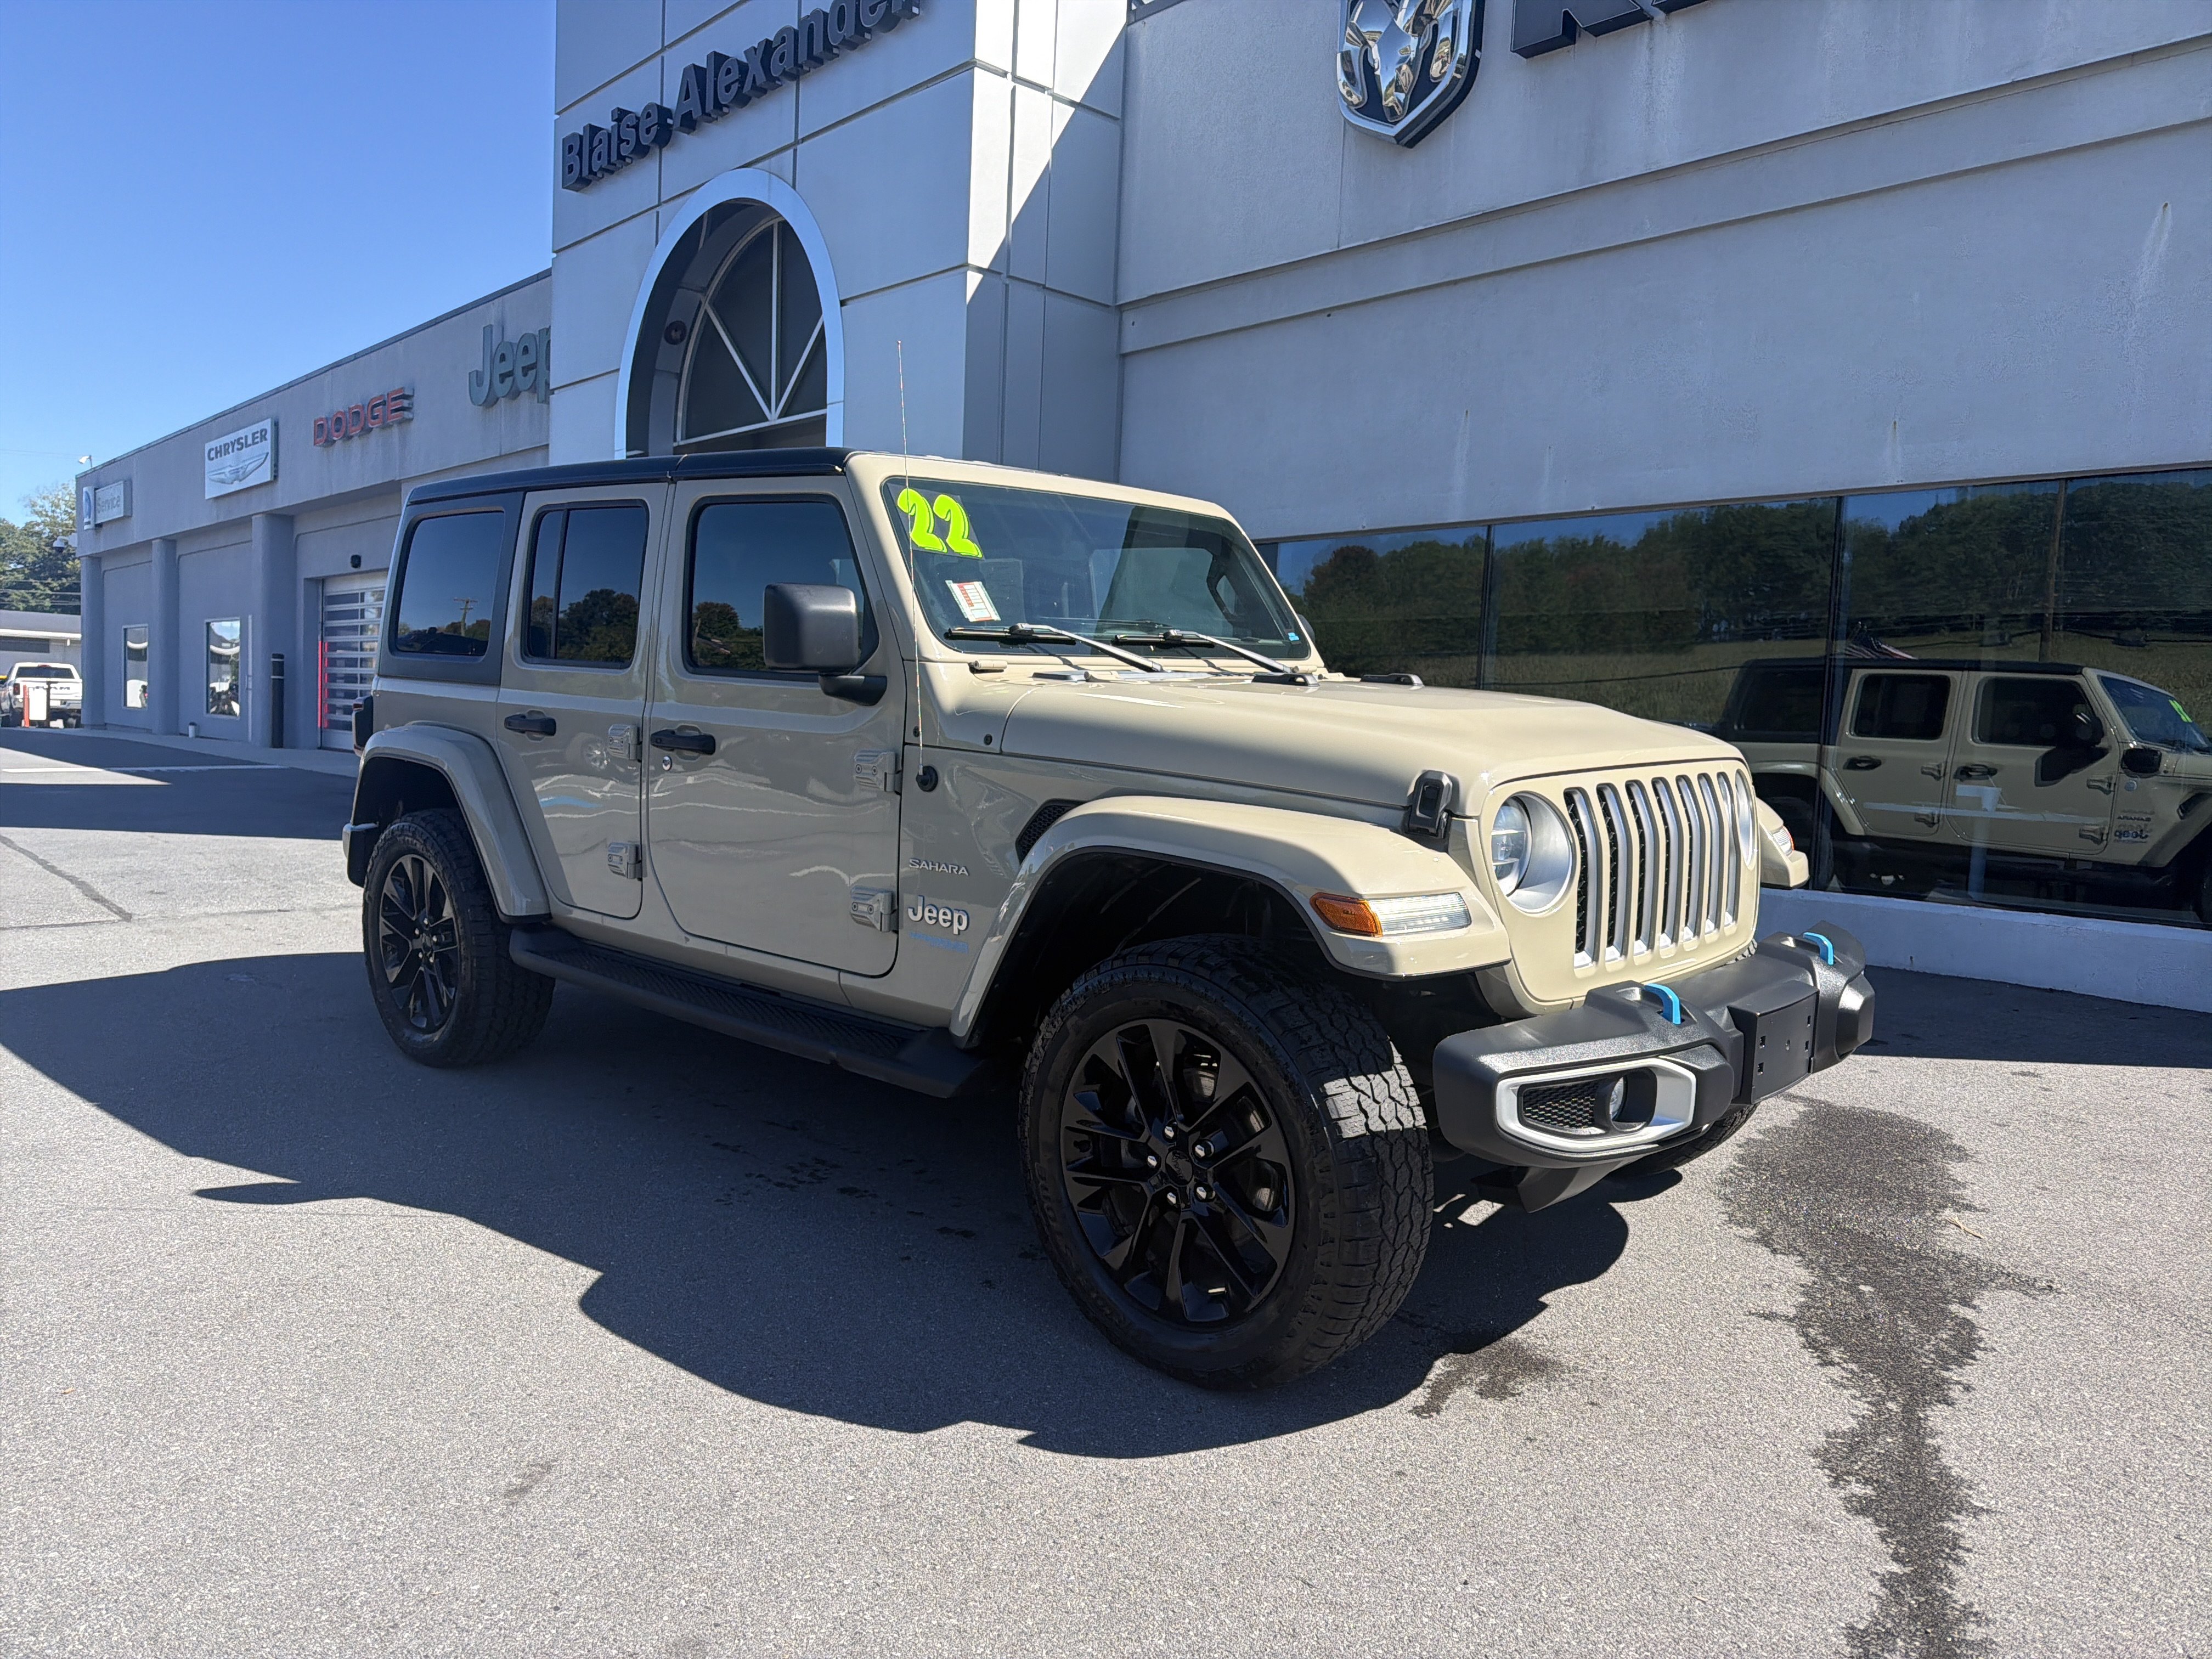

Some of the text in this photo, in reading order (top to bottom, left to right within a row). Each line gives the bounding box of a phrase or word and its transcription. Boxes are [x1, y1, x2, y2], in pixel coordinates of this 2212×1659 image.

[562, 0, 921, 191] Blaise Alexande
[313, 387, 411, 447] DODGE
[207, 428, 268, 461] CHRYSLER
[97, 495, 121, 514] Service
[898, 488, 983, 558] 22
[909, 858, 969, 876] SAHARA
[908, 895, 970, 935] Jeep
